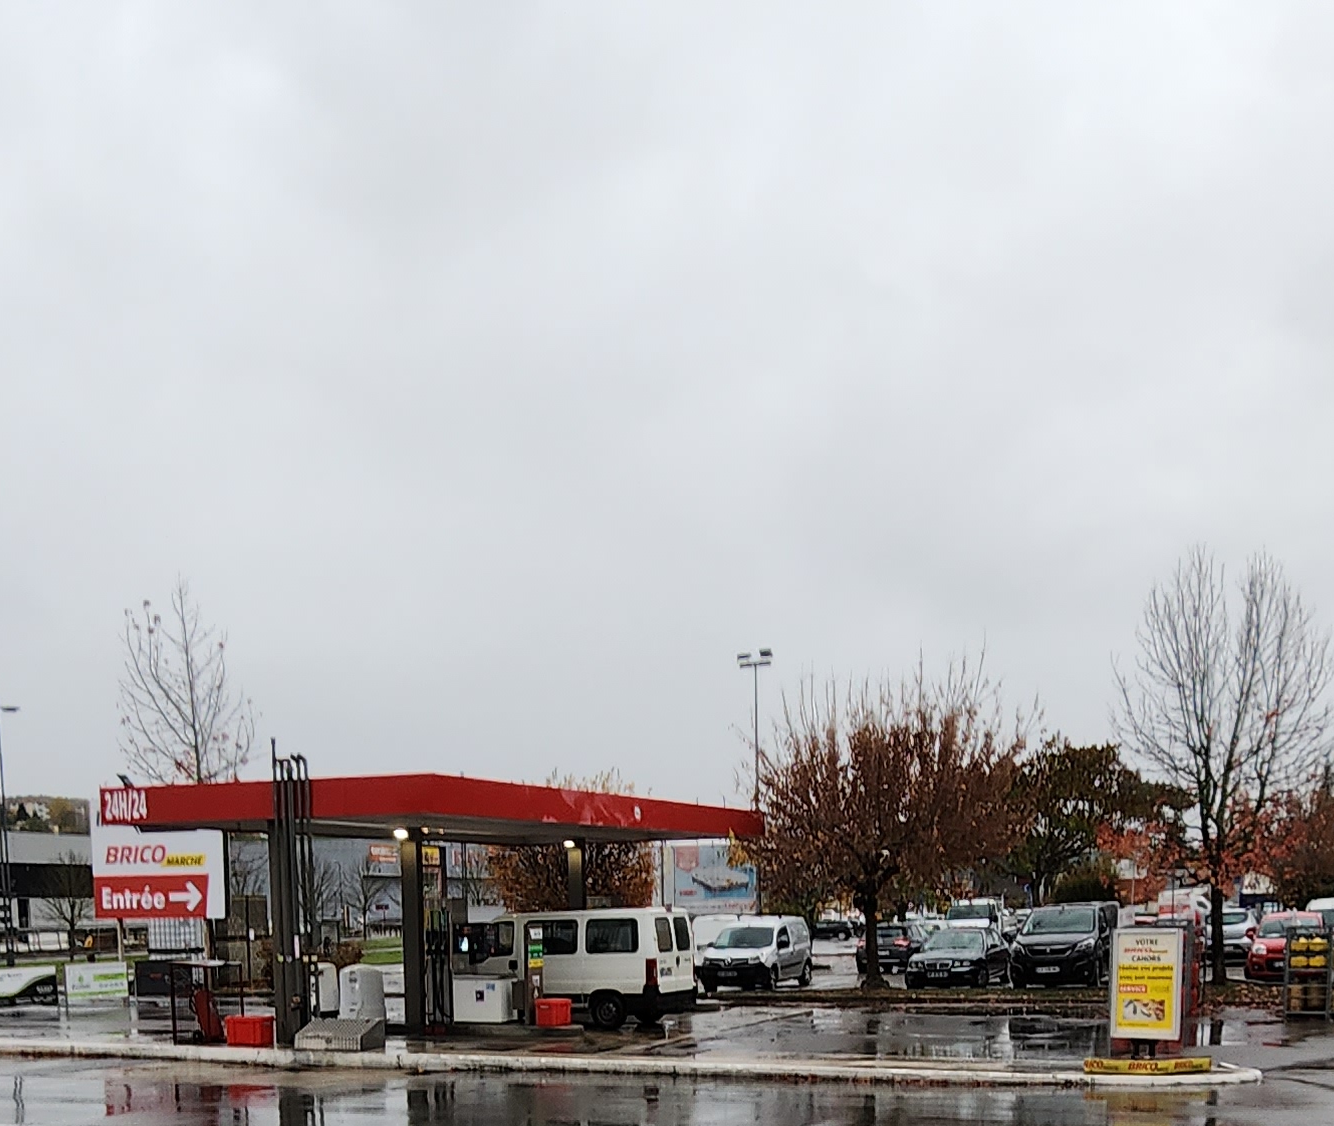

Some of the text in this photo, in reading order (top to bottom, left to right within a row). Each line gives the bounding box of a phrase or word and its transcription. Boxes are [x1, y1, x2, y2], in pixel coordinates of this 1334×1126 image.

[104, 789, 147, 821] 24H/24
[105, 844, 166, 864] BRICO
[101, 884, 165, 910] Entrée
[1128, 1062, 1159, 1072] BRICO
